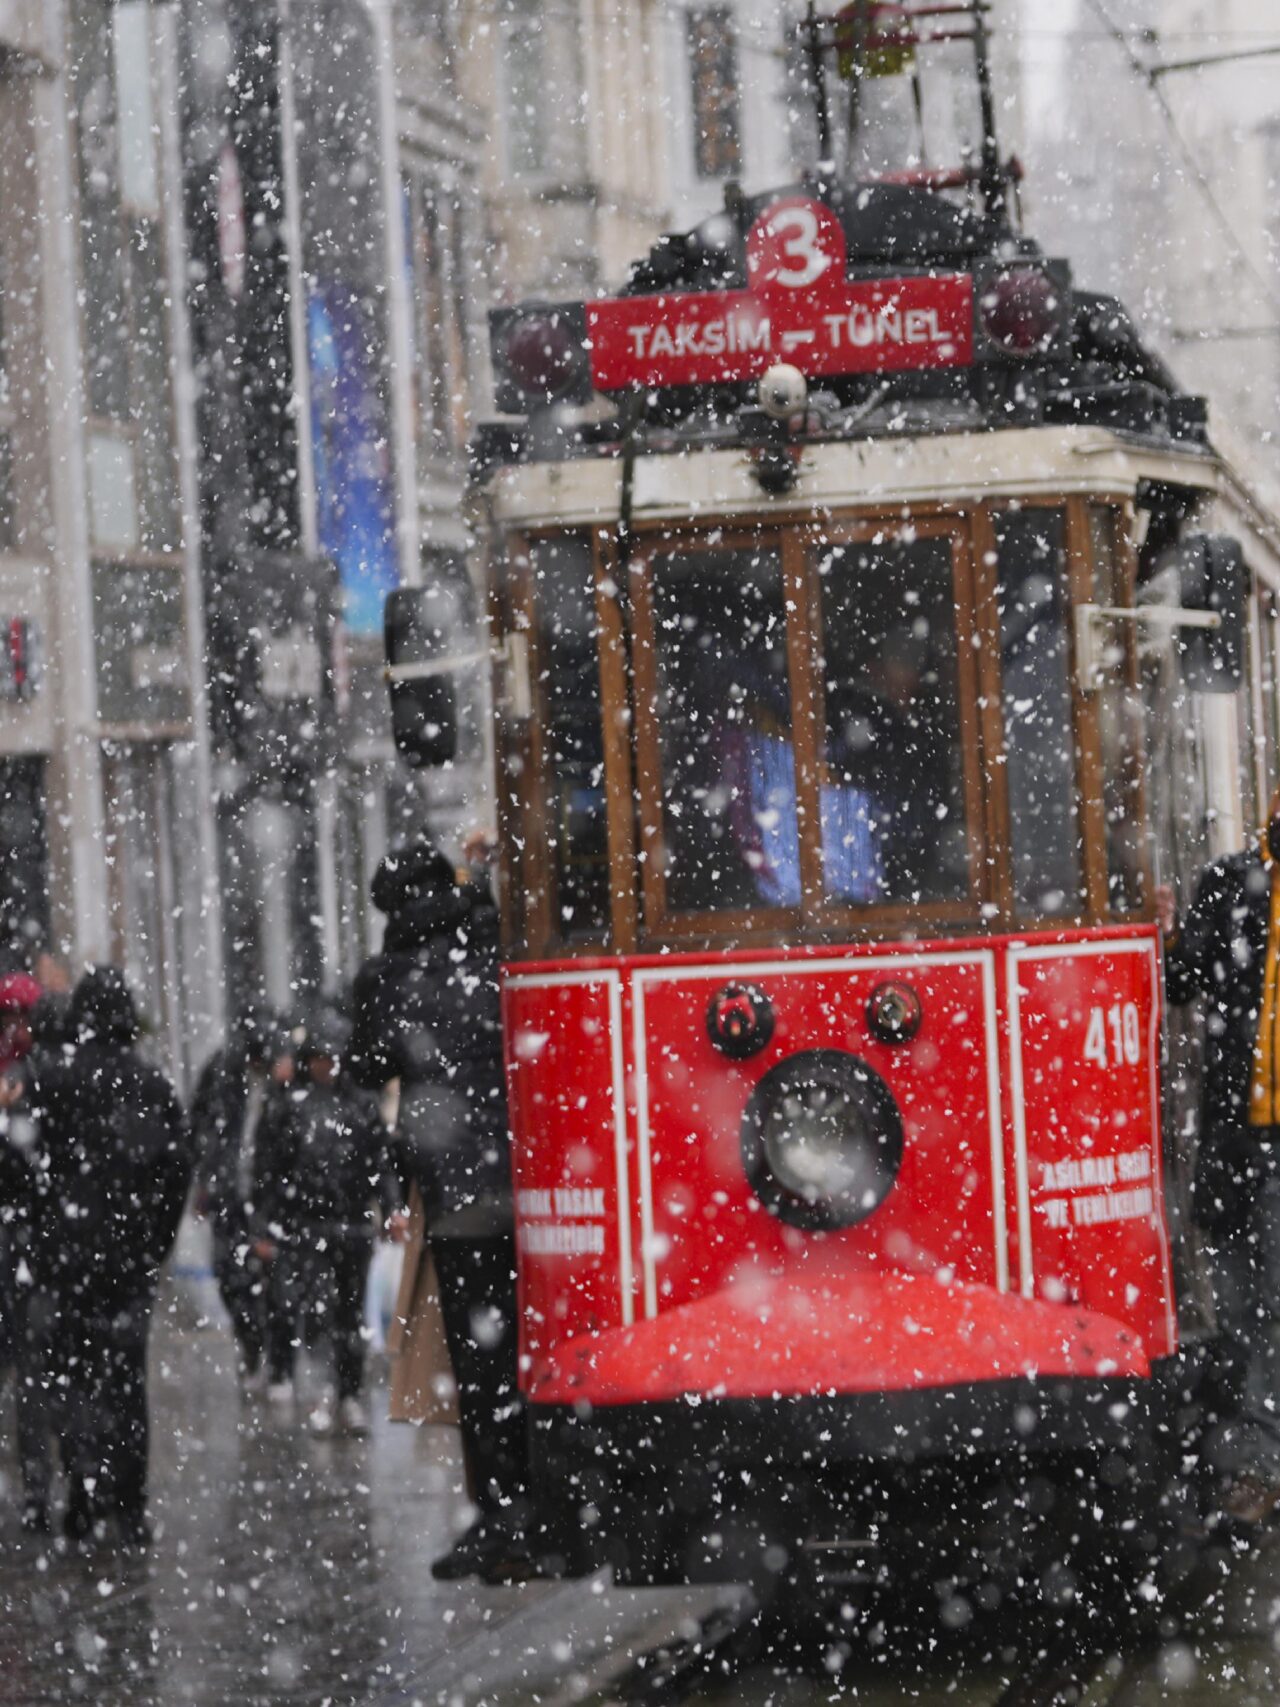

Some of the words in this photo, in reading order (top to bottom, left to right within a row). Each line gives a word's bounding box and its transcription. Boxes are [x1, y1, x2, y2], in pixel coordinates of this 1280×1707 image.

[770, 207, 825, 287] 3
[628, 311, 770, 359] TAKSİM
[824, 303, 952, 348] TÜNEL
[1083, 1001, 1140, 1069] 410
